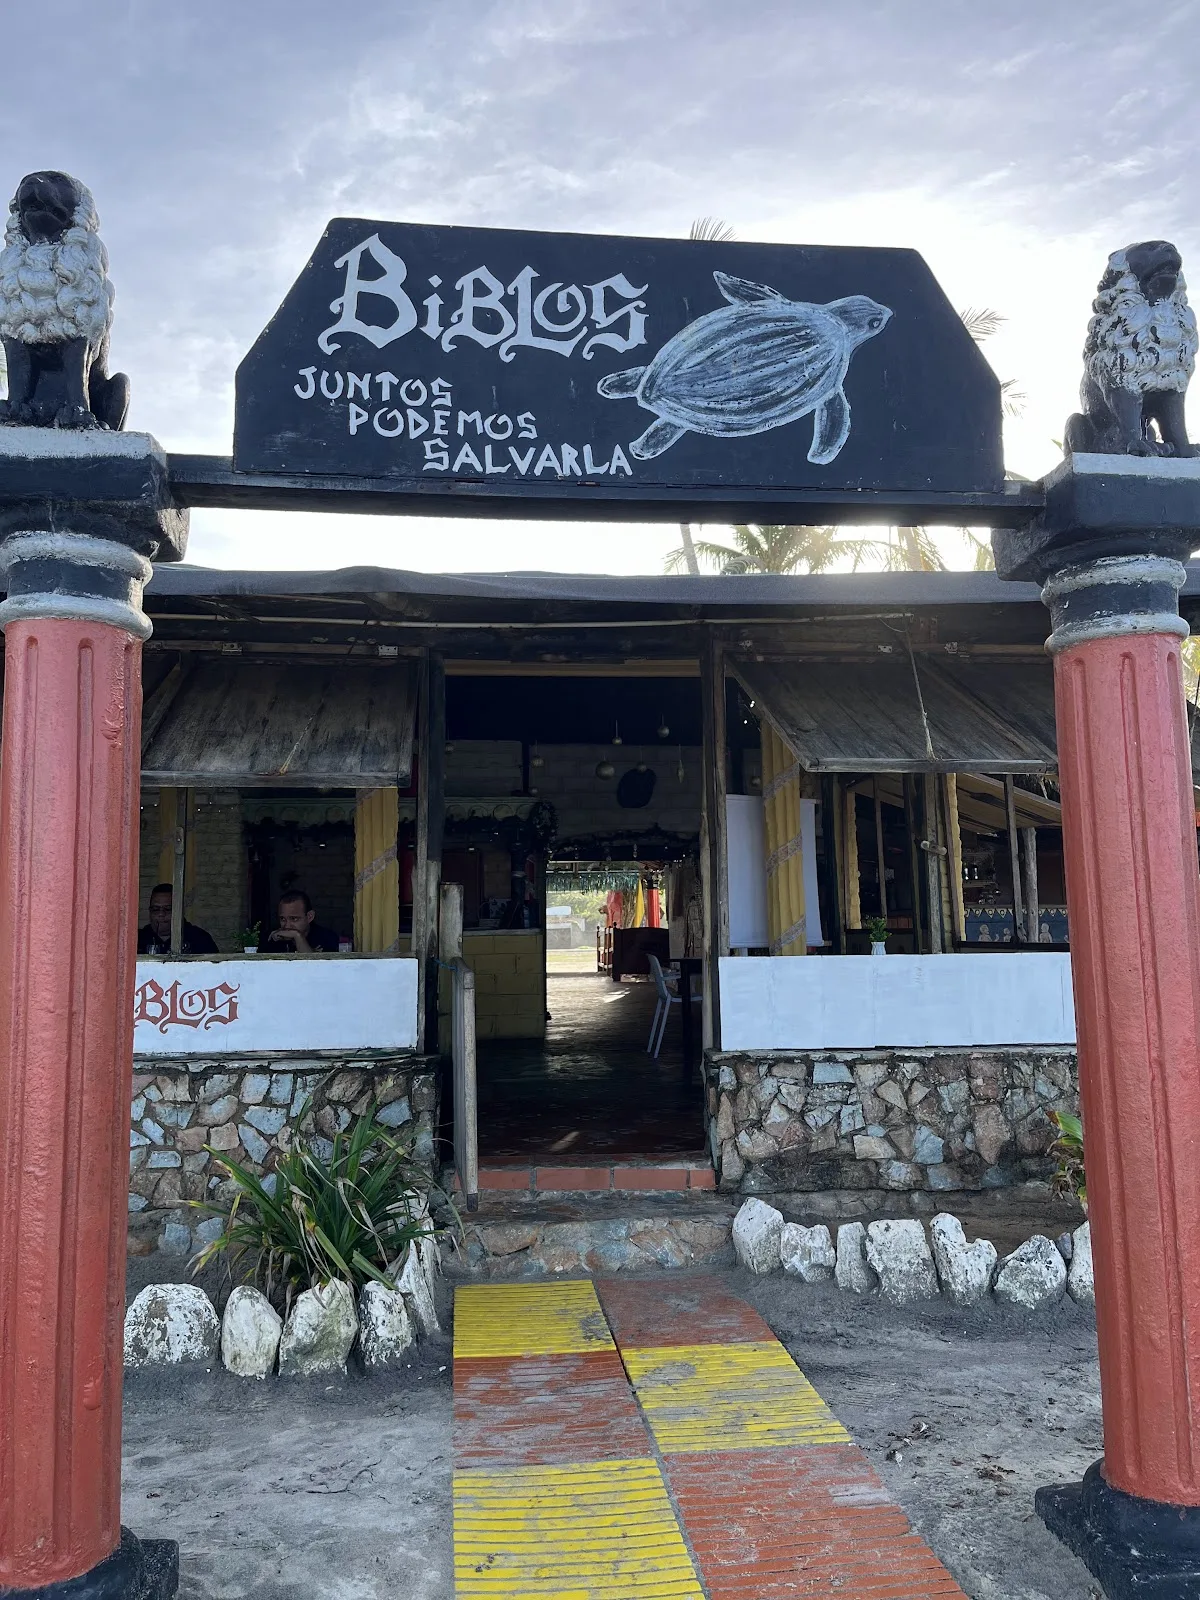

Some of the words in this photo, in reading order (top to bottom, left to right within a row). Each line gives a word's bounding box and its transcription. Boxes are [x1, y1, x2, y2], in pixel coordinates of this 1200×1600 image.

[318, 233, 649, 363] BiBLOS
[294, 366, 453, 407] JUNTOS
[349, 403, 538, 440] PODEMOS
[422, 438, 632, 477] SALVARLA
